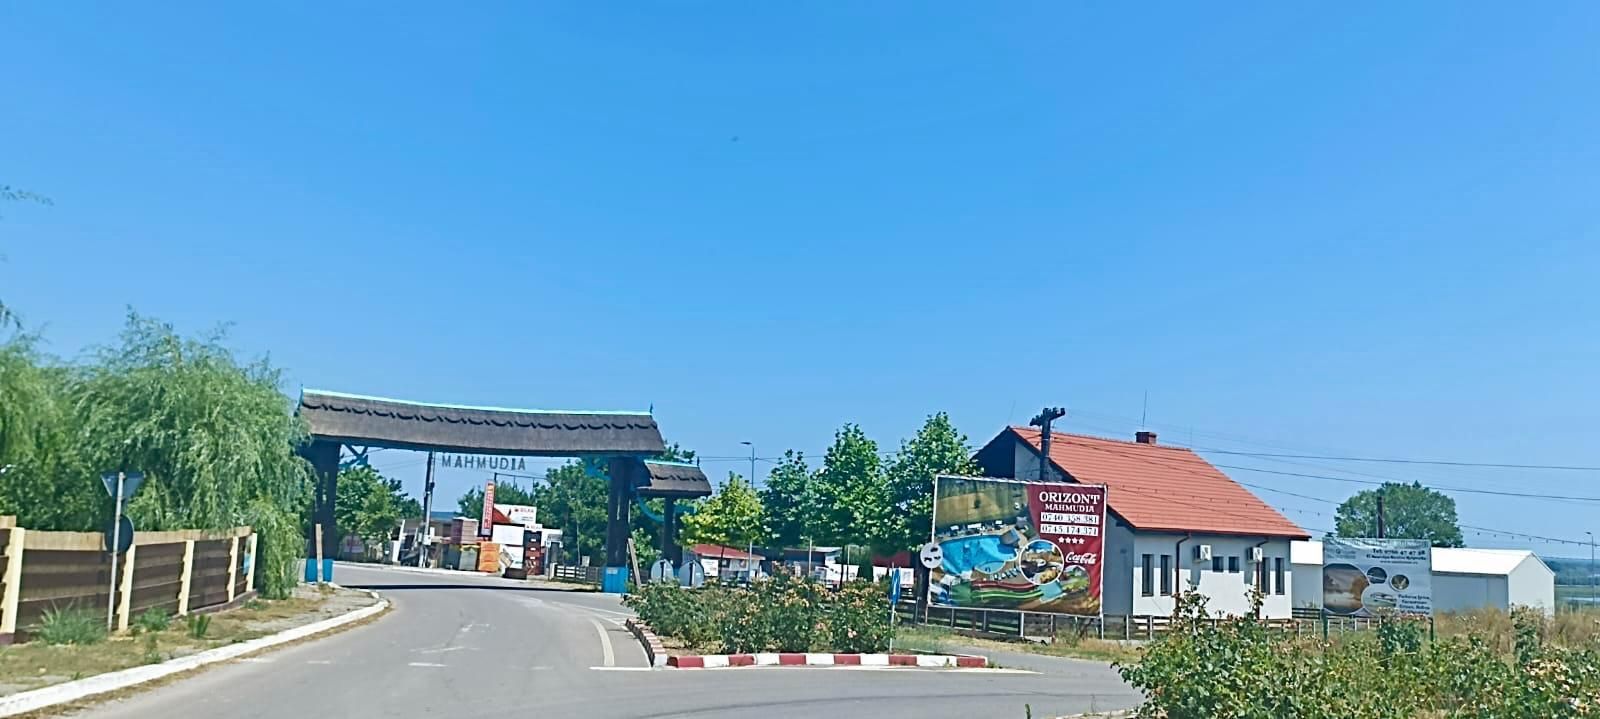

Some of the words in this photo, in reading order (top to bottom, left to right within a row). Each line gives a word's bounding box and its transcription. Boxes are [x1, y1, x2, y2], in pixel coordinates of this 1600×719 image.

[442, 455, 526, 471] MAHMUDIA
[1039, 491, 1101, 505] ORIZONT
[1045, 503, 1095, 513] MAHMUDIA
[1042, 513, 1064, 522] 0740
[1042, 524, 1064, 533] 0745
